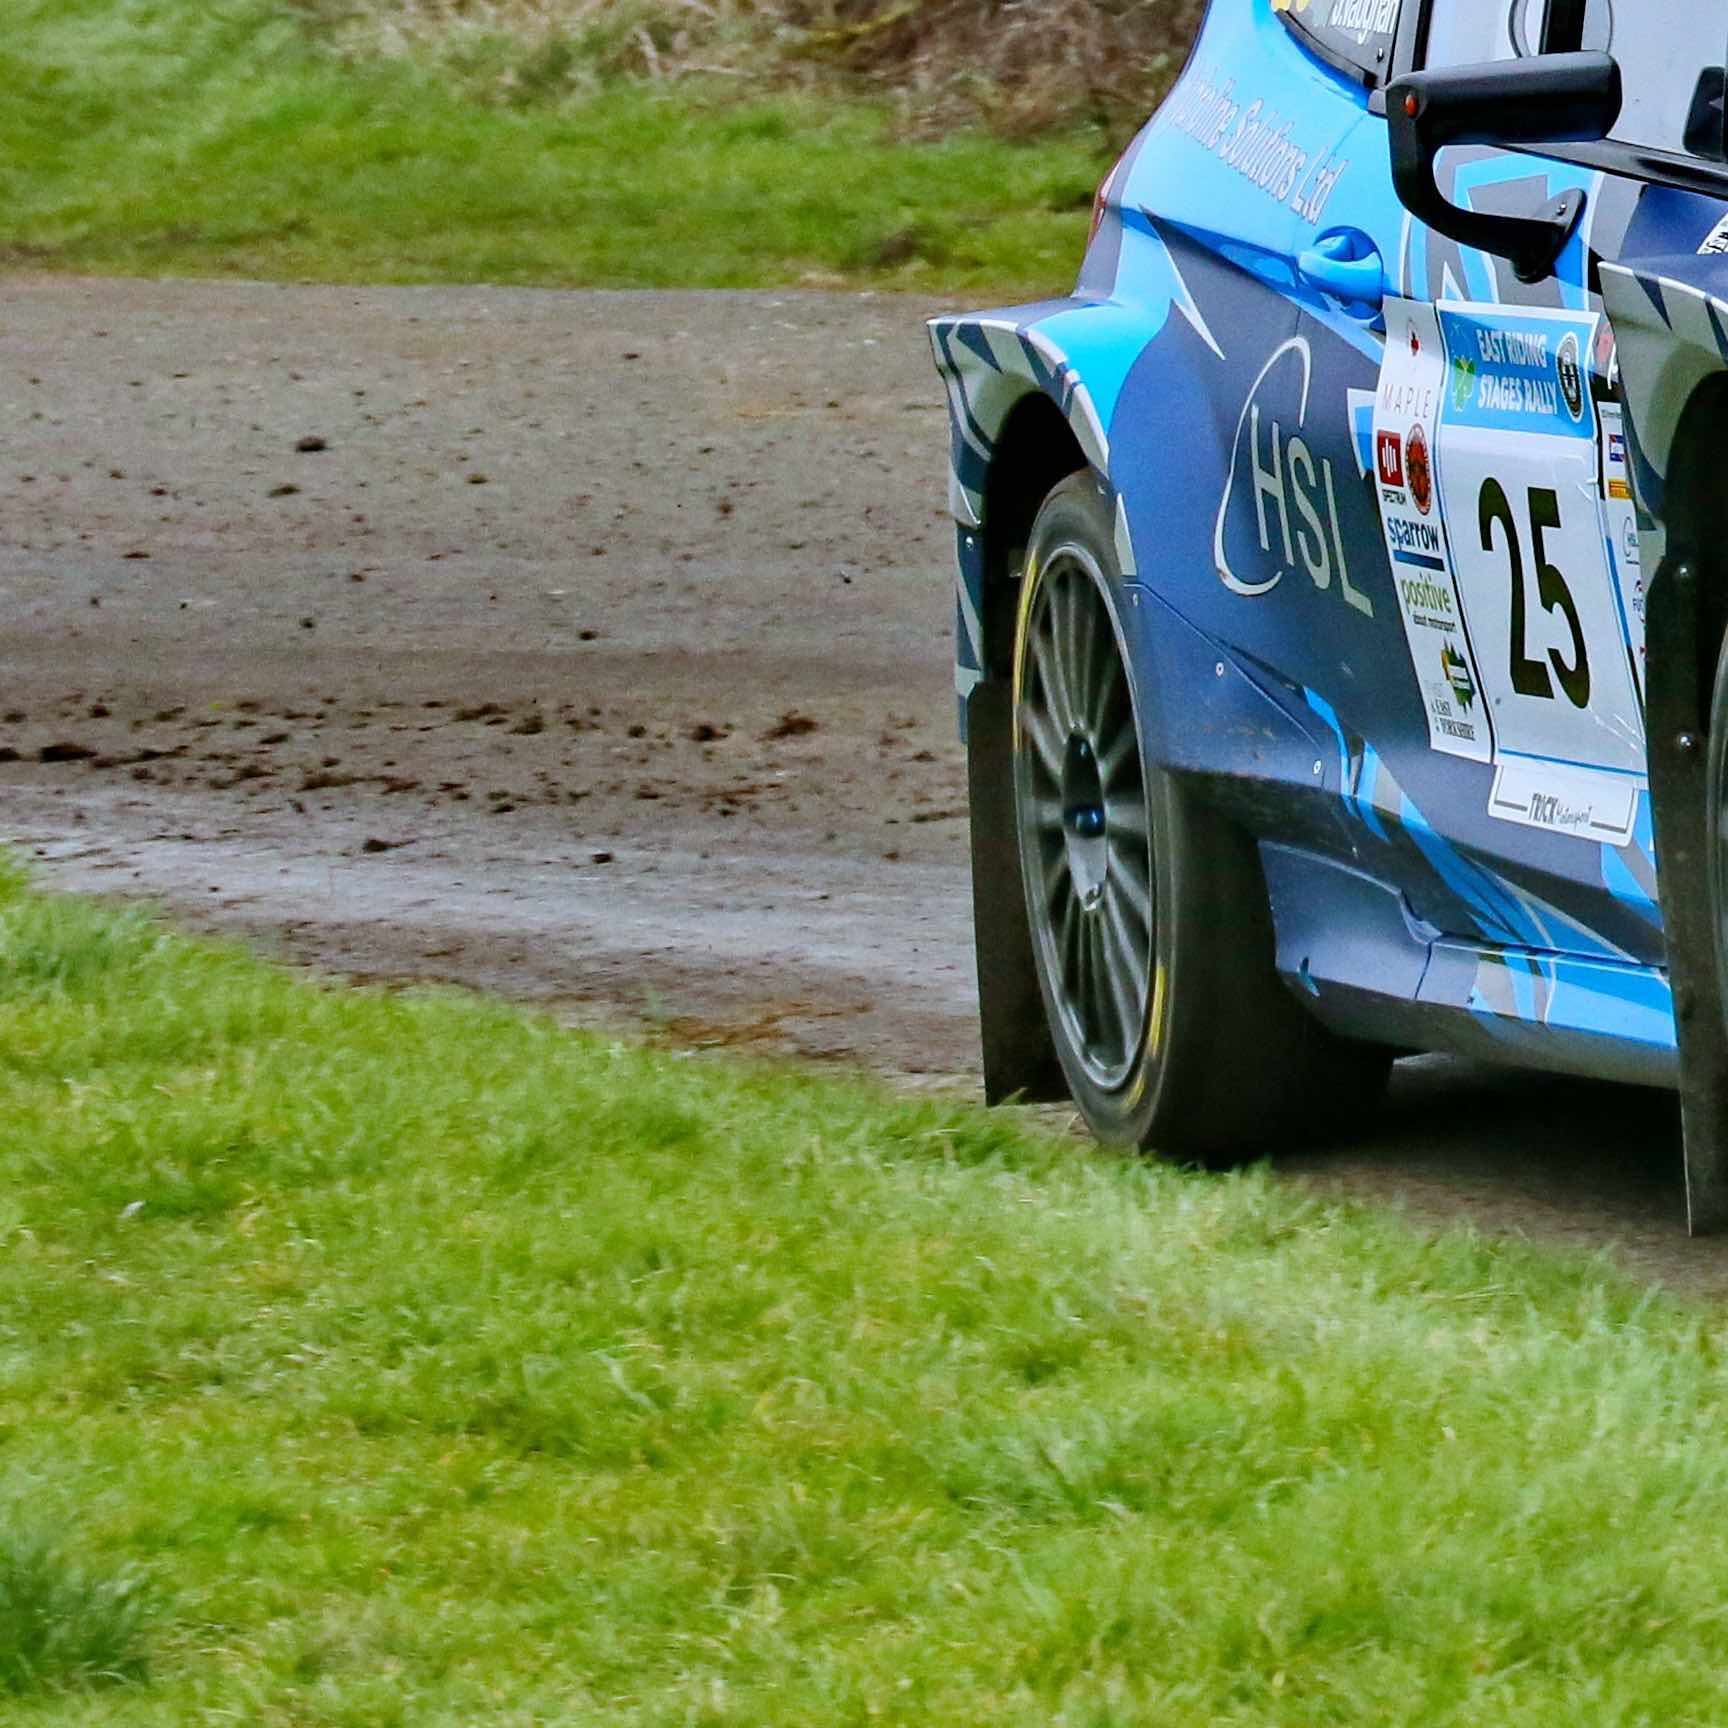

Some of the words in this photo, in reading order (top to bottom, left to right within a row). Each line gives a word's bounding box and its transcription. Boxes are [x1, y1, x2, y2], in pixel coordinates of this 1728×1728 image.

[1477, 329, 1502, 362] EAST
[1505, 331, 1548, 368] RIDING
[1478, 374, 1522, 412] STAGES
[1524, 378, 1558, 415] RALLY
[1251, 403, 1374, 617] HSL
[1387, 516, 1440, 553] sparrow
[1401, 572, 1451, 616] positive
[1478, 476, 1591, 710] 25
